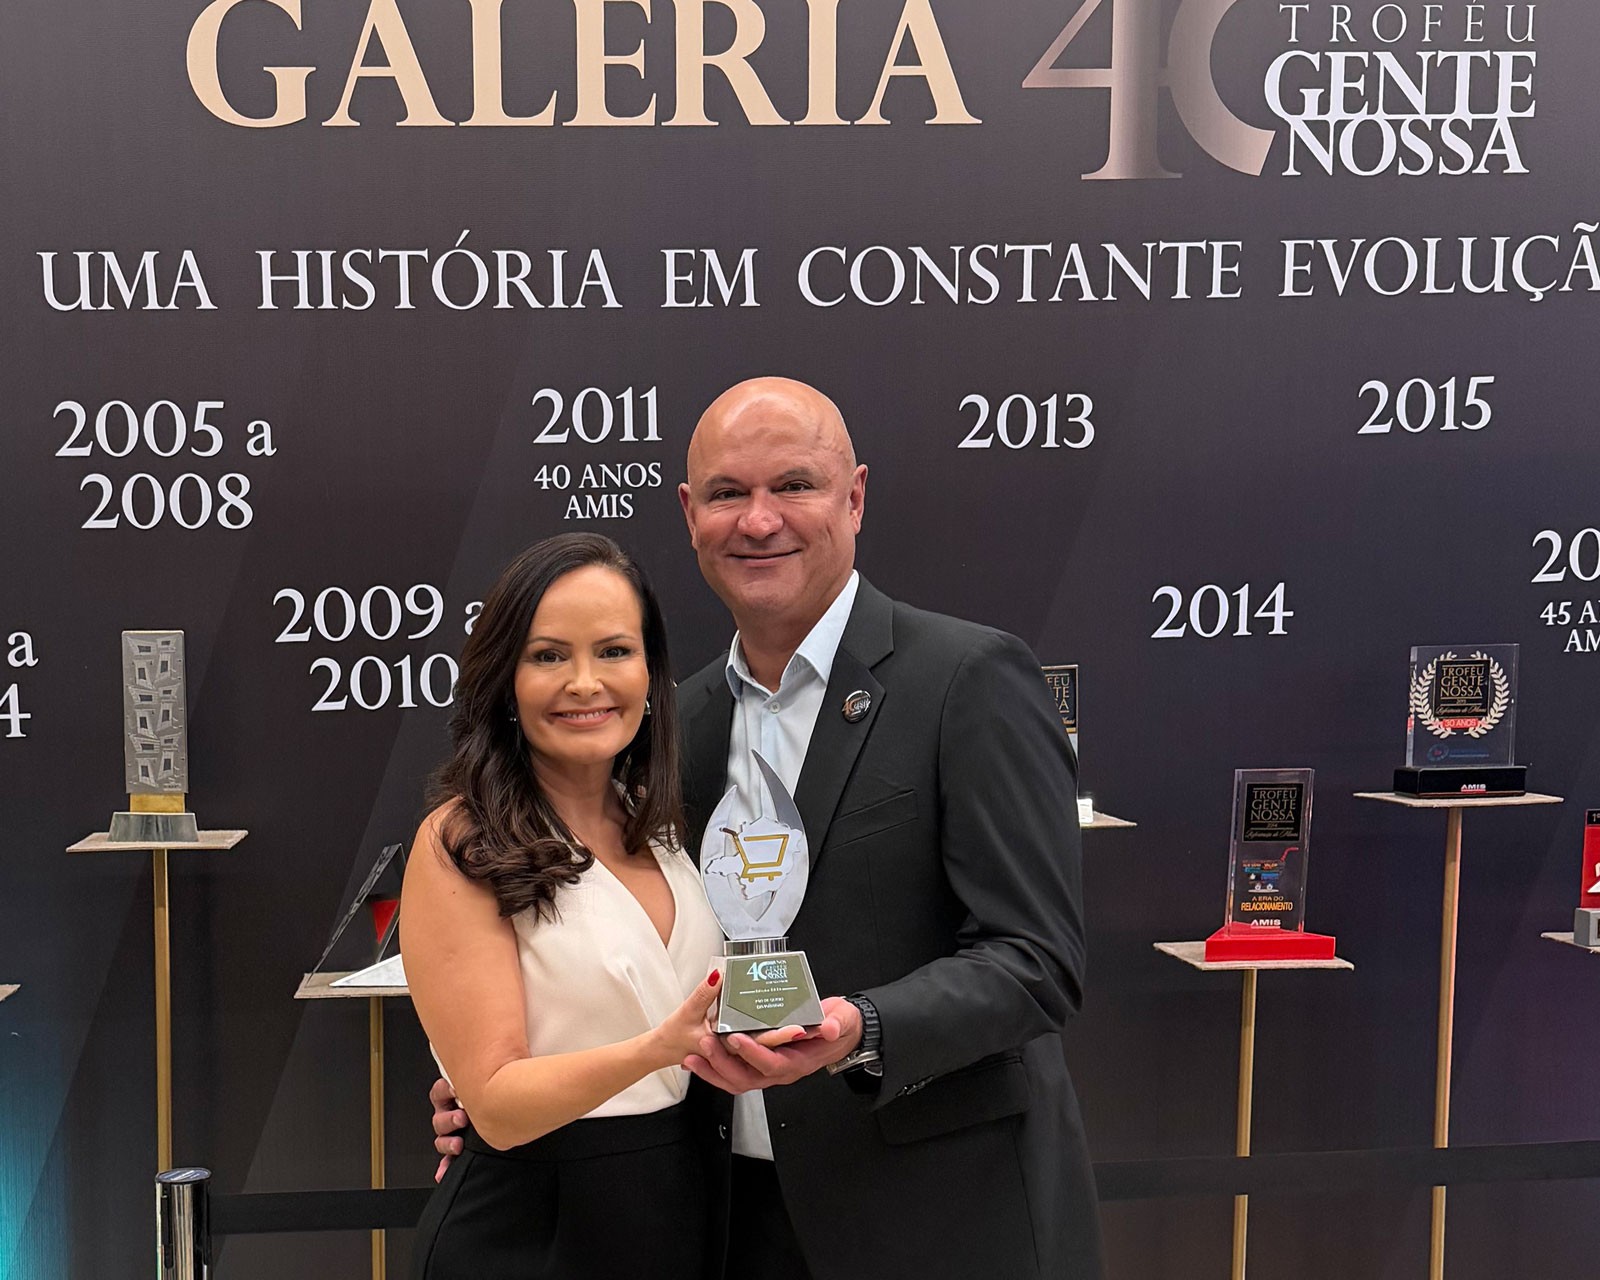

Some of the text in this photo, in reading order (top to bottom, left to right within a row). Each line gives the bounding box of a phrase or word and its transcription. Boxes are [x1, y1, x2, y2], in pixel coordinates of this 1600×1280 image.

[1279, 0, 1536, 43] TROFÉU
[187, 0, 982, 127] GALERIA
[1265, 50, 1536, 119] GENTE
[1282, 116, 1530, 176] NOSSA
[37, 222, 1600, 311] UMA HISTÓRIA EM CONSTANTE EVOLUÇÃ
[53, 401, 277, 457] 2005 a
[532, 386, 662, 443] 2011
[957, 393, 1095, 449] 2013
[1357, 376, 1495, 435] 2015
[80, 473, 253, 530] 2008
[533, 462, 662, 490] 40 ANOS
[564, 493, 634, 519] AMIS
[1531, 527, 1600, 583] 20
[273, 584, 443, 643] 2009
[1151, 582, 1294, 638] 2014
[1540, 600, 1600, 626] 45 A
[7, 631, 39, 668] a
[309, 653, 459, 711] 2010
[1440, 686, 1483, 697] NOSSA
[1441, 676, 1484, 687] GENTE
[1250, 809, 1295, 821] NOSSA
[1251, 799, 1296, 810] GENTE
[1461, 783, 1487, 791] AMIS
[1241, 902, 1293, 911] RELACIONAMENTO
